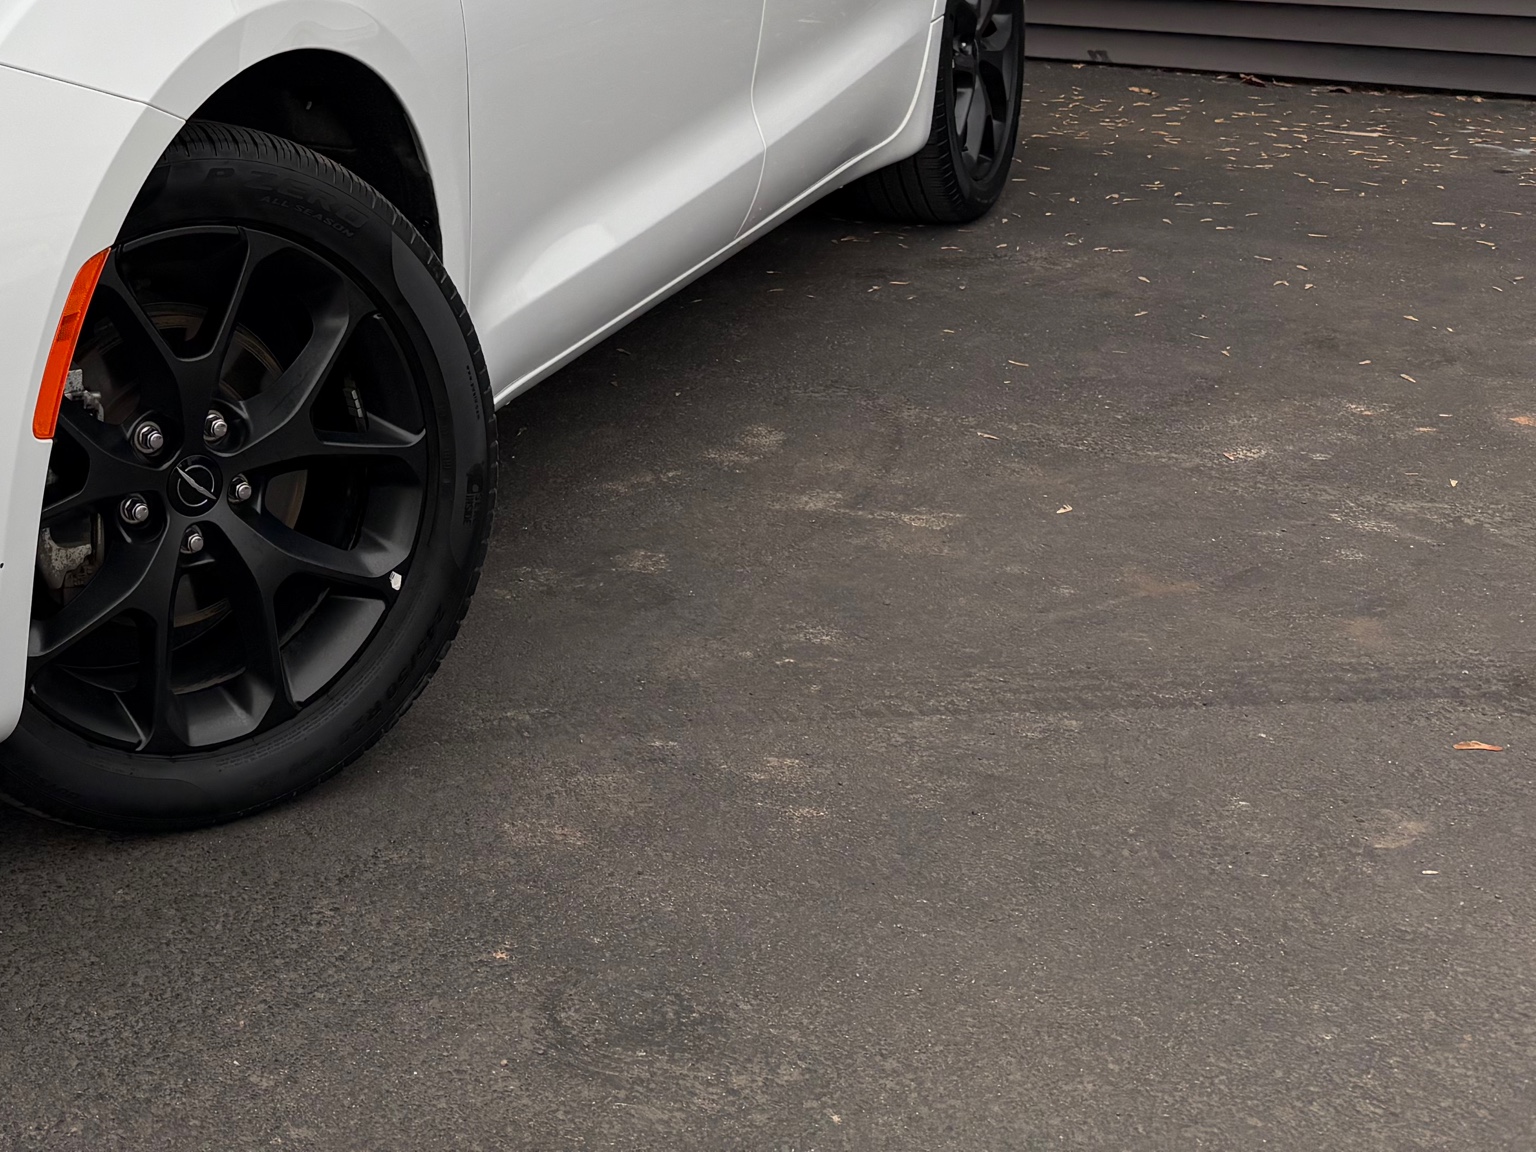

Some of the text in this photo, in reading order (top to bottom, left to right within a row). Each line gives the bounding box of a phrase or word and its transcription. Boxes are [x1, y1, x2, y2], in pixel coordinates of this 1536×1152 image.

[243, 170, 369, 229] ZERO
[261, 195, 355, 238] ALL SEASON
